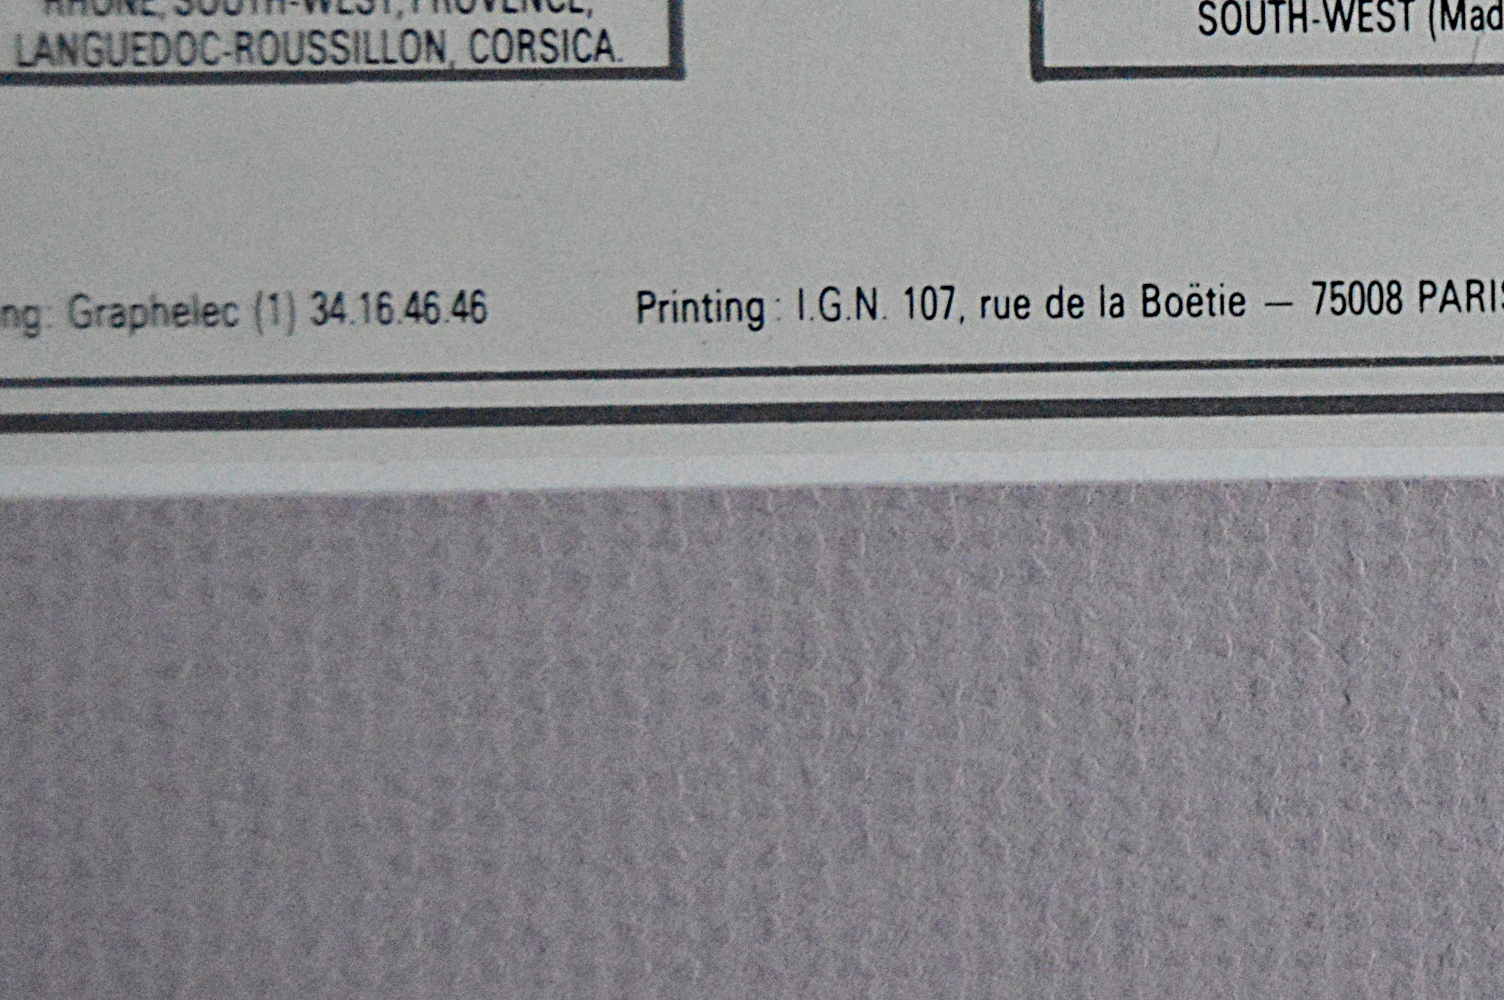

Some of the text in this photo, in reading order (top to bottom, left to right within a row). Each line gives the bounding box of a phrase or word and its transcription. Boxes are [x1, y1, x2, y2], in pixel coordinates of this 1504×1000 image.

[15, 26, 624, 71] LANGUEDOC-ROUSSILLON, CORSICA.
[67, 292, 240, 335] Graphelec
[252, 289, 297, 337] (1)
[310, 288, 488, 327] 34.16.46.46
[904, 284, 965, 325] 107,
[980, 294, 1031, 321] rue
[1044, 284, 1085, 320] de
[1099, 283, 1125, 319] la
[1141, 282, 1247, 319] Boëtie
[1311, 278, 1404, 317] 75008
